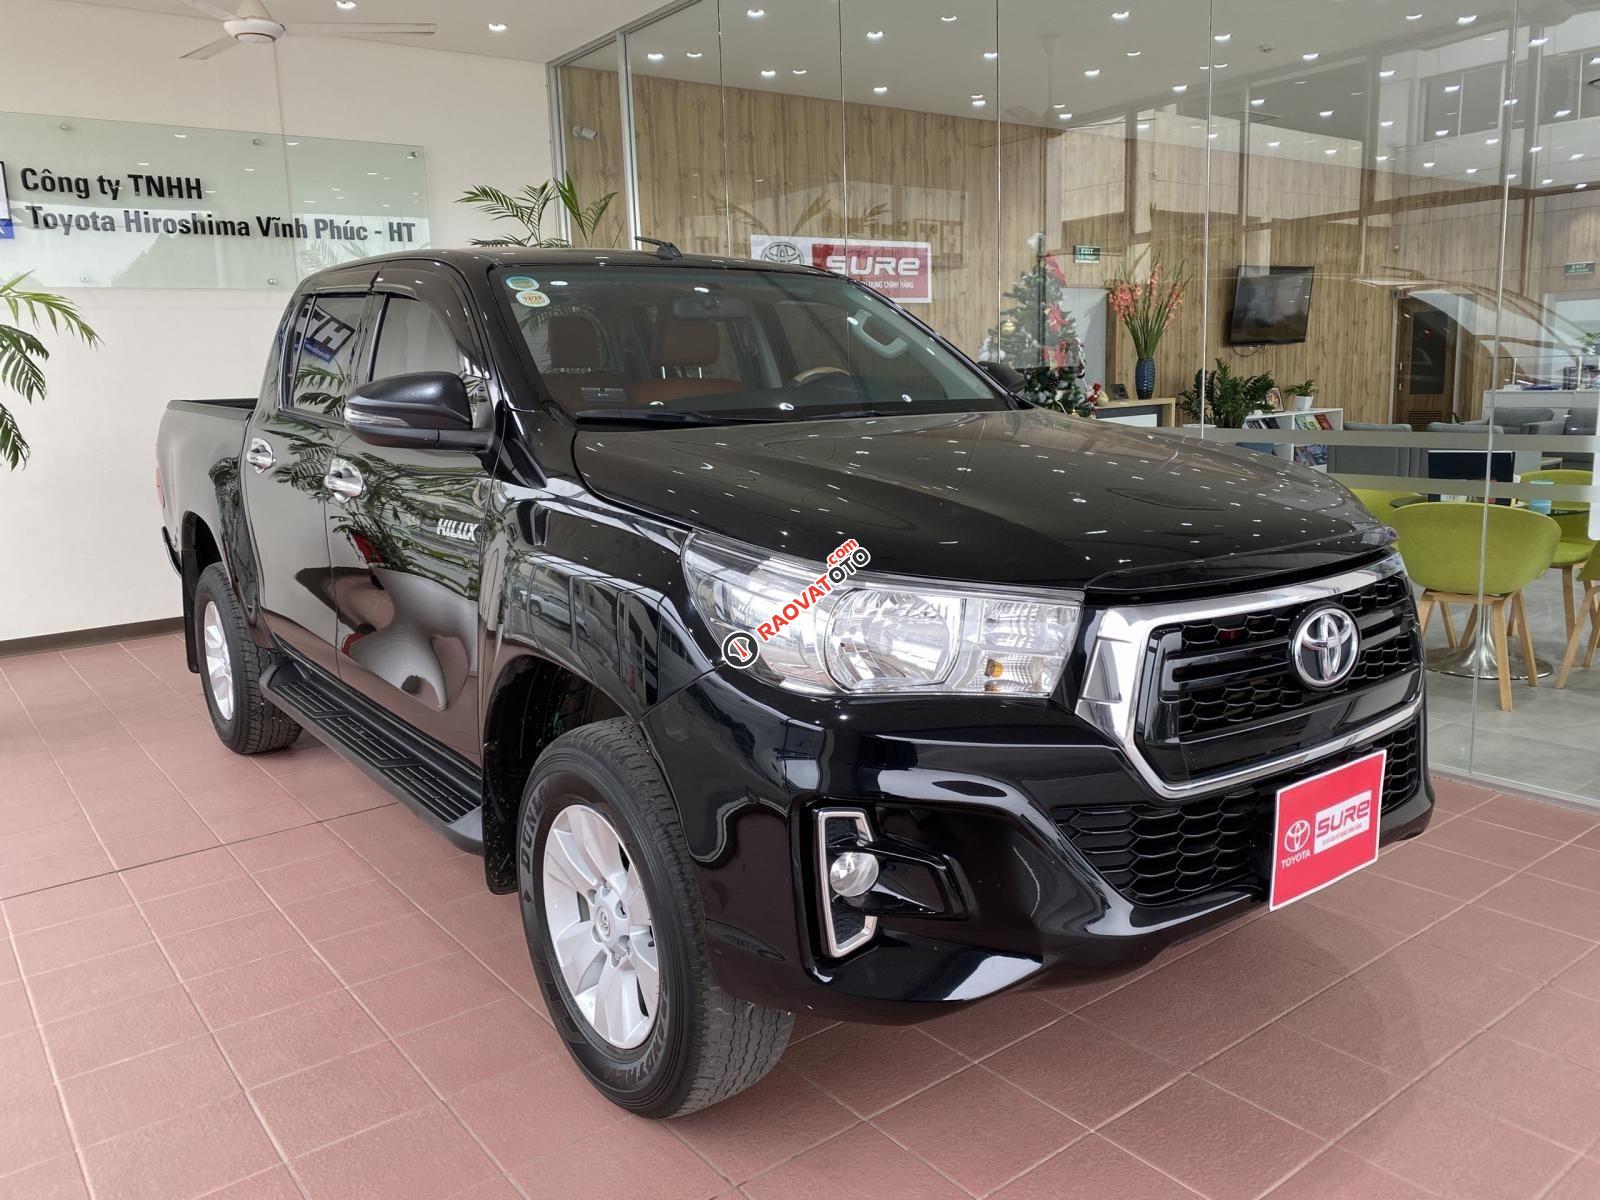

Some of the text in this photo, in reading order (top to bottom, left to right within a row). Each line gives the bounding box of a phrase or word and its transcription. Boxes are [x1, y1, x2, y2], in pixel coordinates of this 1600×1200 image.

[20, 168, 203, 201] Công ty TNHH
[25, 205, 116, 236] Toyota
[123, 209, 250, 237] Hiroshima
[256, 215, 308, 239] Vĩnh
[314, 218, 369, 241] Phúc
[388, 221, 416, 242] HT
[826, 256, 920, 275] SURE
[436, 518, 480, 542] HILUX
[1317, 800, 1370, 838] SURE
[1281, 848, 1311, 869] TOYOTA
